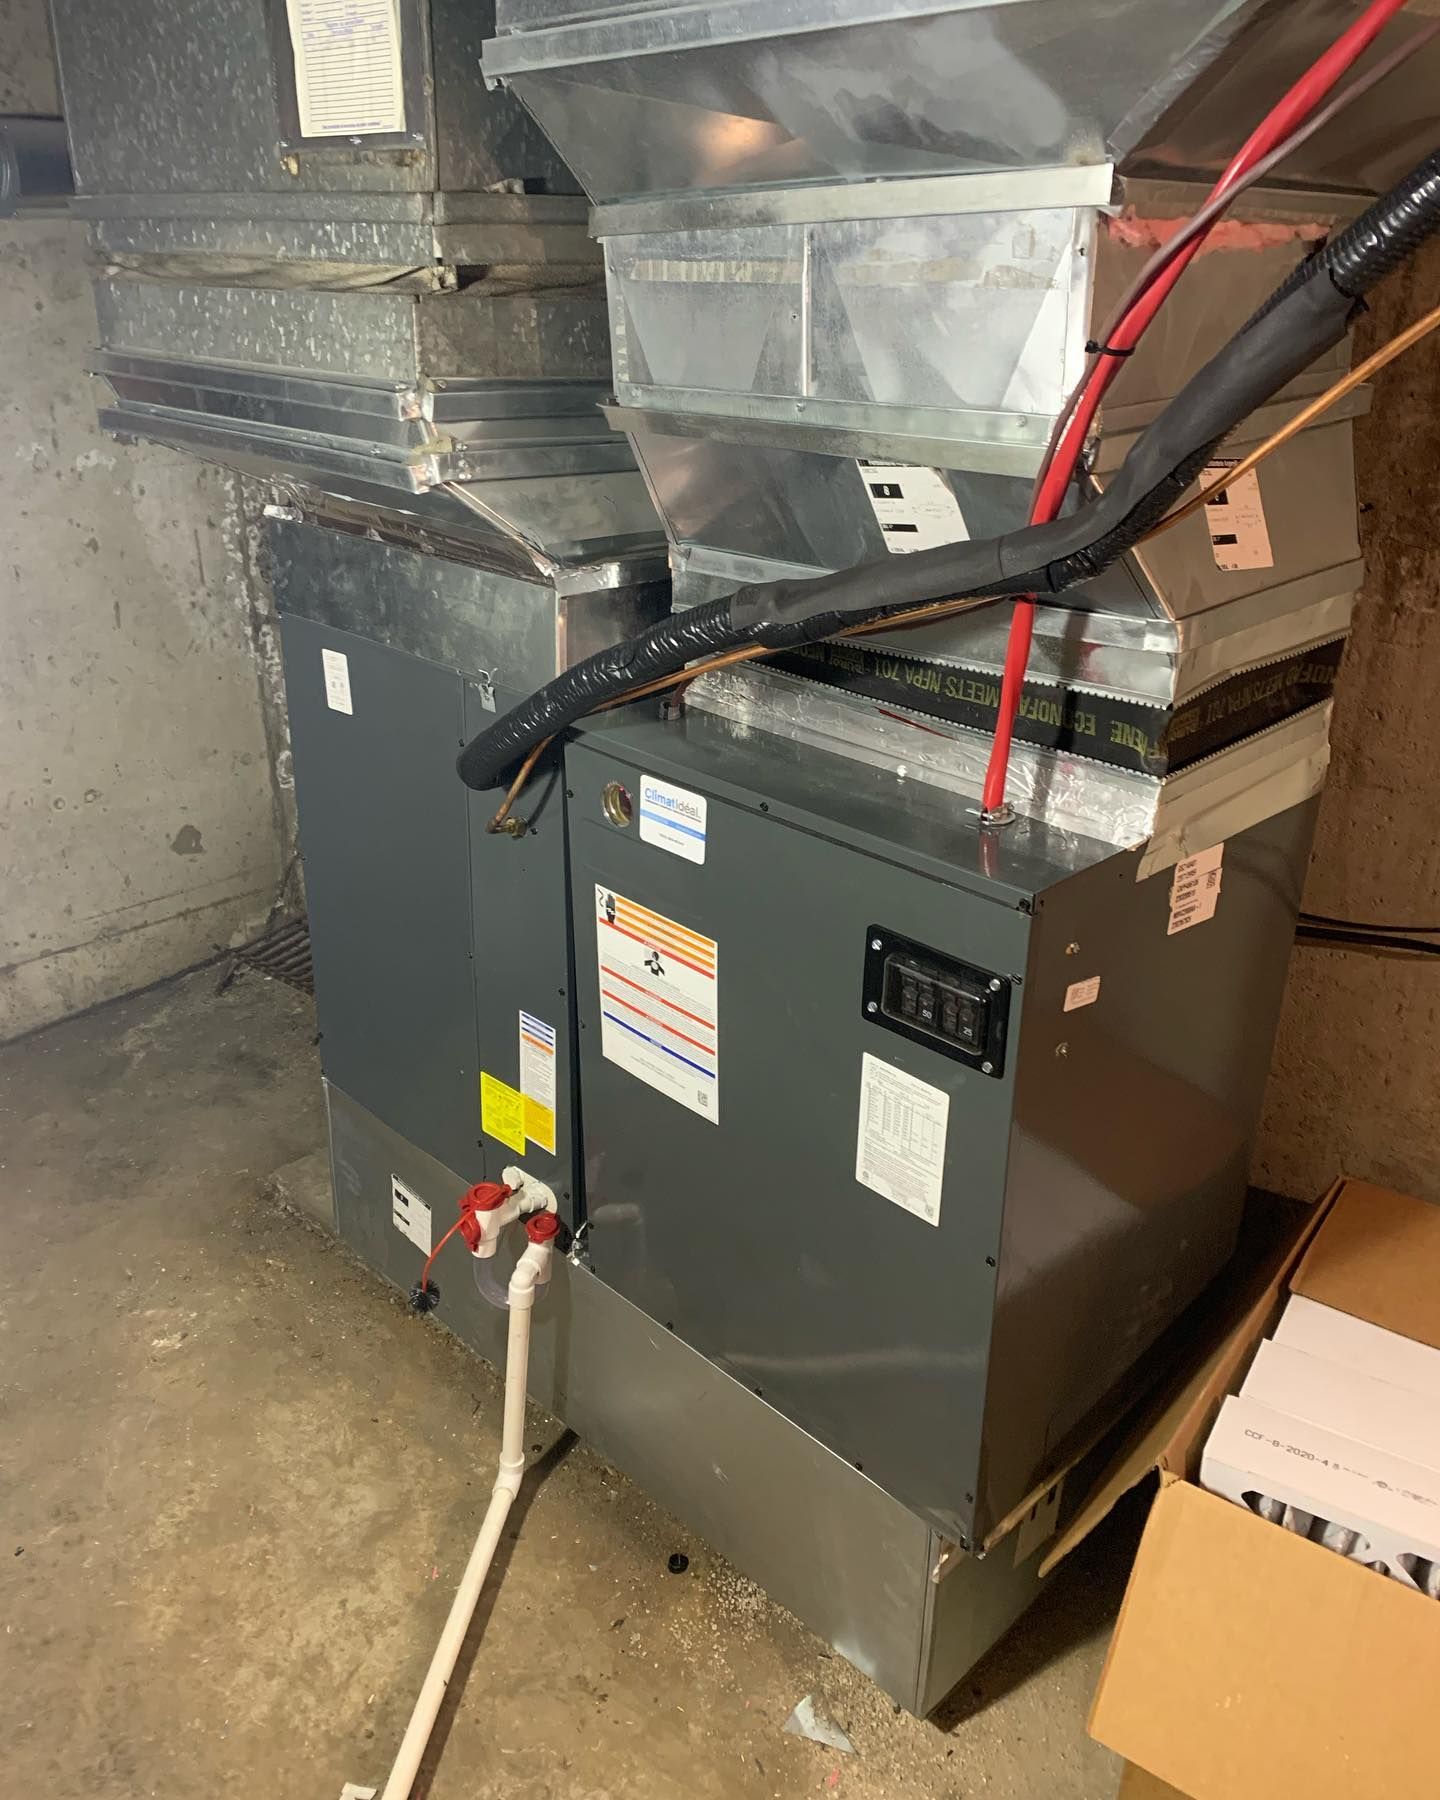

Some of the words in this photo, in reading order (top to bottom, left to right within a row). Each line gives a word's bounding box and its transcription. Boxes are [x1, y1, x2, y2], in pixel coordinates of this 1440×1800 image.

[873, 657, 900, 681] 701
[905, 663, 943, 694] NFPA
[946, 675, 1000, 708] MEETS
[1019, 696, 1096, 736] ECONOFA
[922, 1008, 933, 1020] 50
